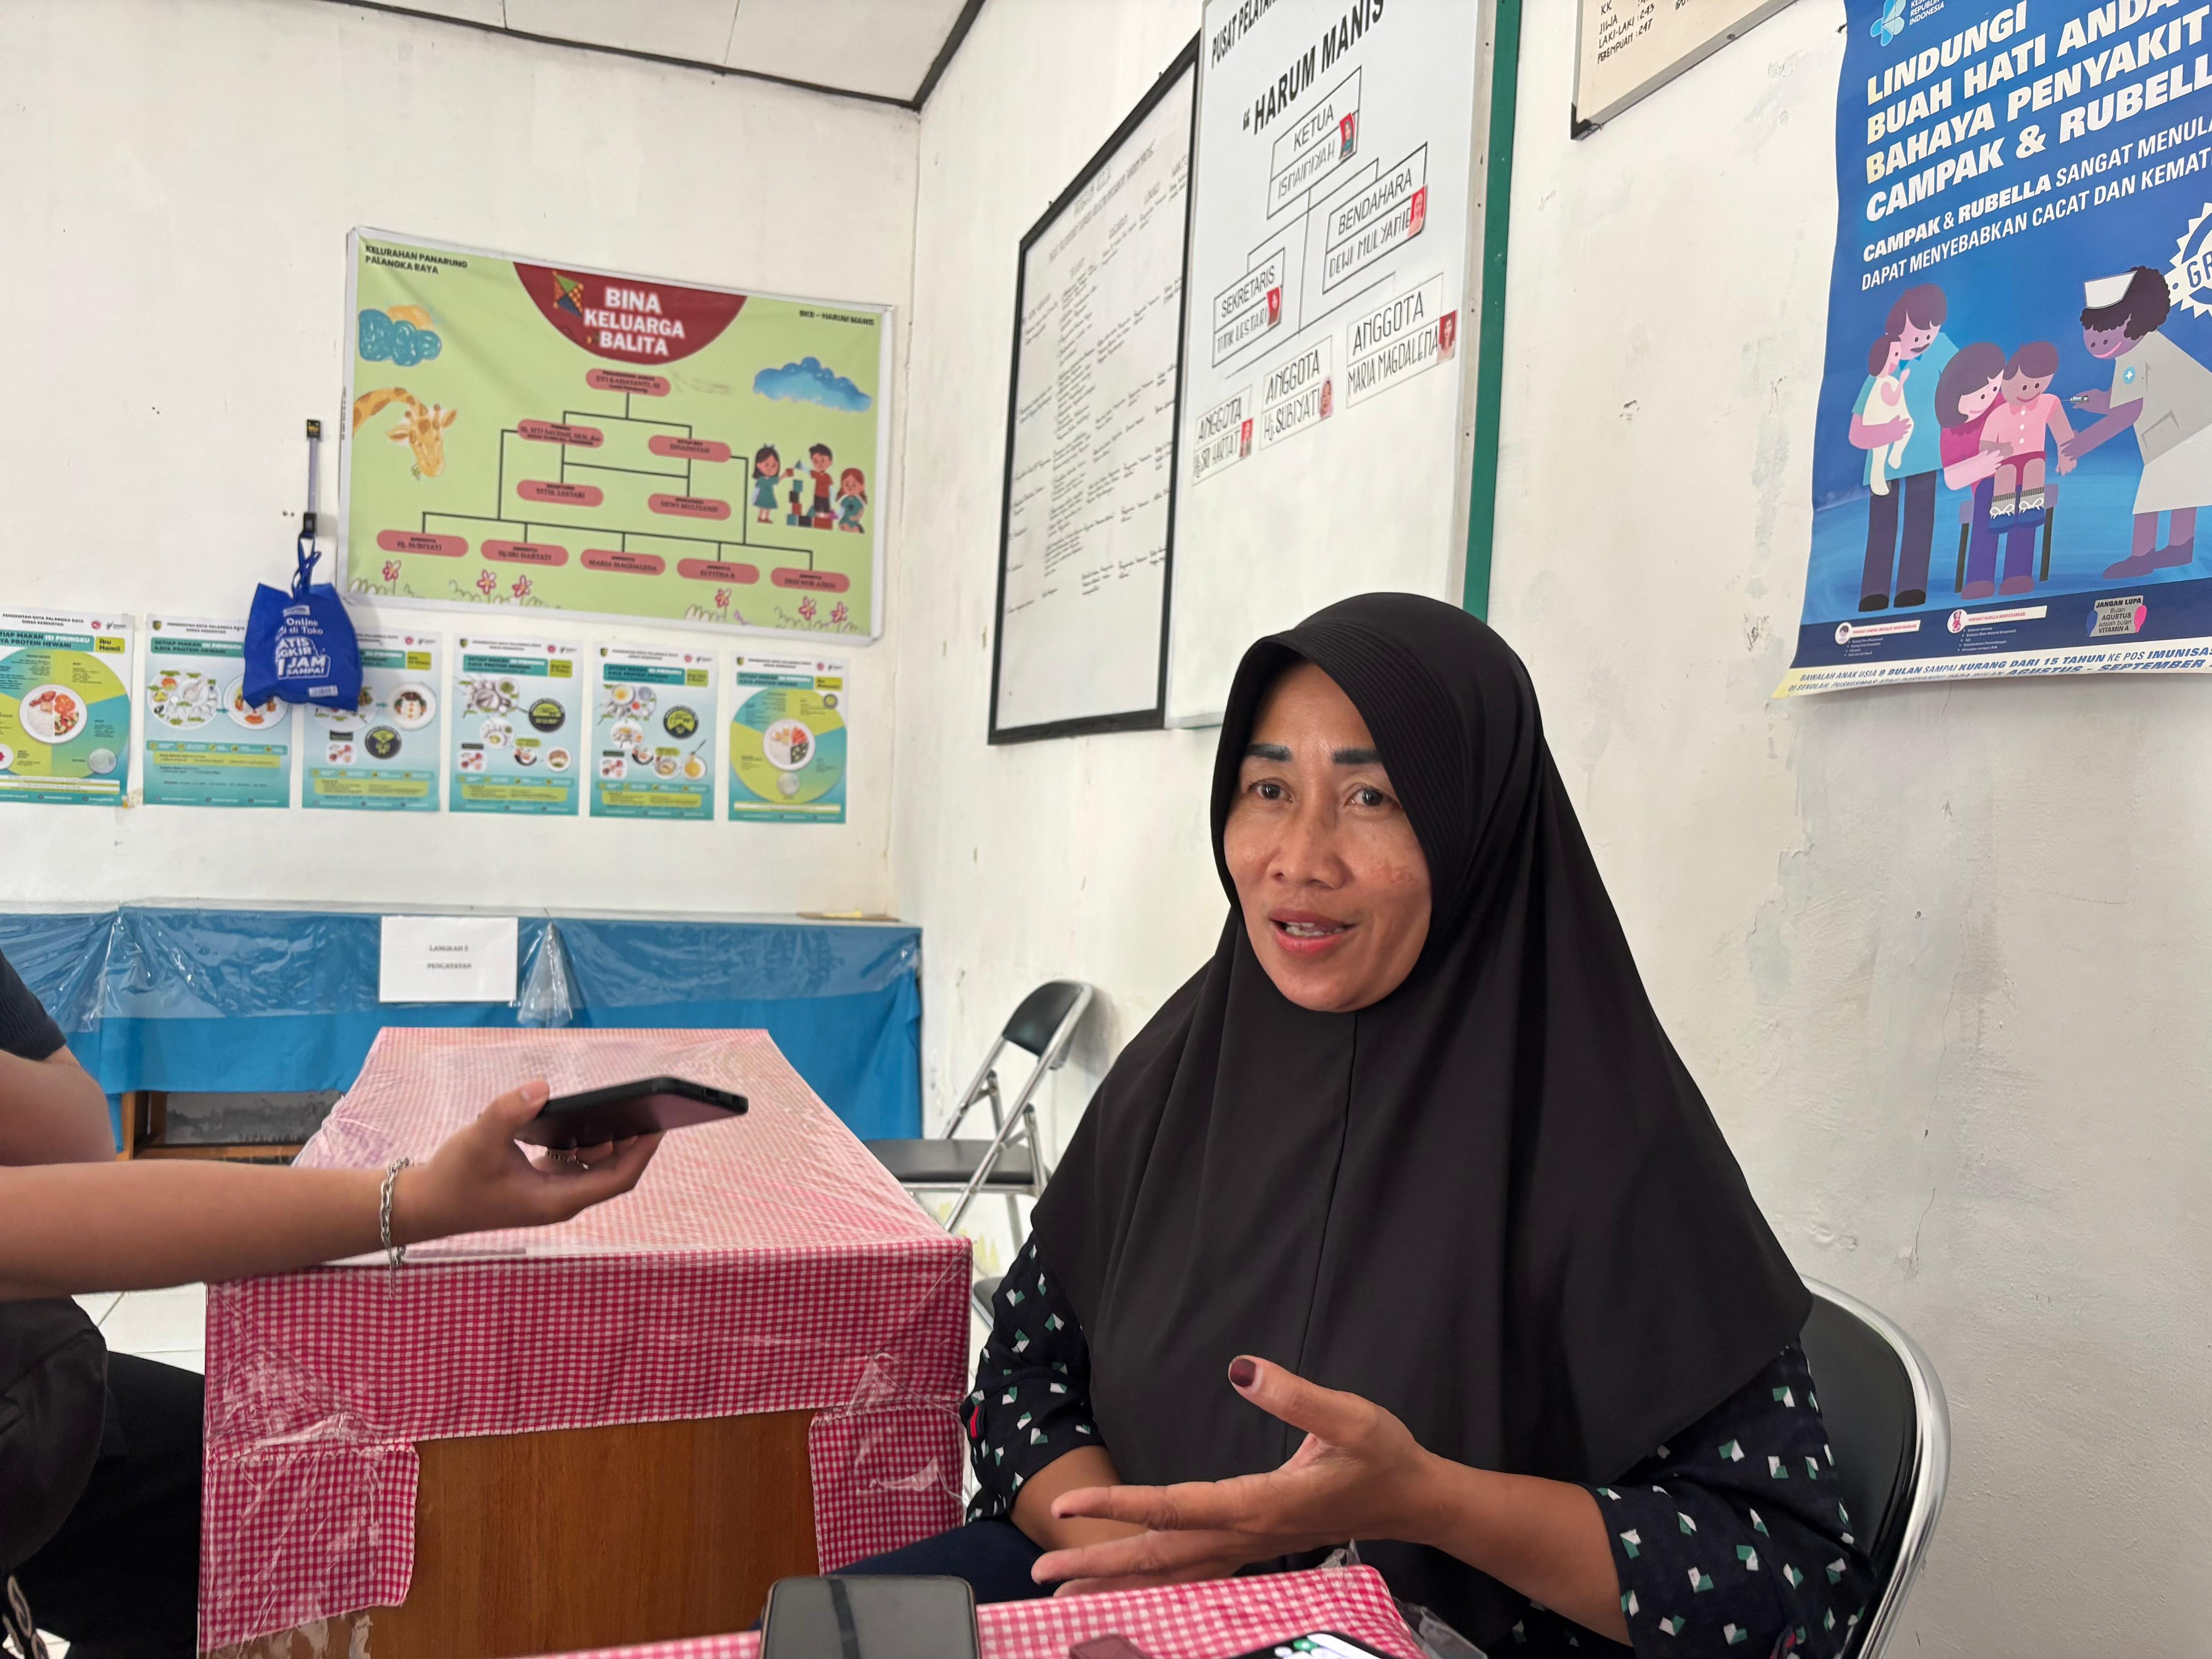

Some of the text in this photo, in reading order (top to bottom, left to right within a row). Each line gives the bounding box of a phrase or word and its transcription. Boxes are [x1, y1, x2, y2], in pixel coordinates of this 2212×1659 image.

[1601, 0, 1612, 15] KK
[1909, 1, 1944, 26] INDONESIA
[1599, 14, 1618, 35] JIWA
[1211, 13, 1237, 69] PUSAT
[1597, 33, 1633, 64] PEREMPUAN
[1867, 1, 2027, 105] LINDUNGI
[1867, 78, 1952, 145] BUAH
[1964, 34, 2046, 99] HATI
[1867, 4, 2210, 184] BAHAYA PENYAKIT
[1294, 104, 1334, 152] KETUA
[1866, 53, 2212, 222] CAMPAK & RUBELL
[1338, 168, 1412, 236] BENDAHARA
[1863, 216, 1940, 262] CAMPAK
[1943, 211, 1955, 230] &
[1958, 174, 2051, 224] RUBELLA
[2056, 143, 2133, 187] SANGAT
[1862, 146, 2212, 290] DAPAT MENYEBABKAN CACAT DAN KEMAT
[365, 245, 468, 269] KELURAHAN PANARUNG
[365, 255, 439, 274] PALANGKA RAYA
[1329, 246, 1353, 278] DEWI
[605, 287, 663, 315] BINA
[1221, 265, 1275, 318] SEKRETARIS
[584, 308, 686, 339] KELUARGA
[1352, 291, 1424, 356] ANGGOTA
[599, 330, 669, 357] BALITA
[1347, 325, 1438, 397] MARIA MAGDALENA
[1265, 349, 1320, 405] ANGGOTA
[2096, 599, 2123, 608] JANGAN
[2101, 612, 2132, 621] AGUSTUS
[286, 618, 319, 627] Online
[301, 626, 324, 635] Toko
[279, 638, 310, 648] ATIS
[280, 646, 312, 657] GKIR
[287, 655, 326, 668] JAM
[1800, 672, 1835, 681] BAWALAH
[1836, 671, 1858, 679] ANAK
[1888, 666, 1923, 675] BULAN
[1923, 664, 1958, 673] SAMPAI
[1958, 660, 2007, 671] KURANG
[2009, 658, 2040, 667] DARI
[2063, 654, 2106, 664] TAHUN
[2107, 653, 2121, 661] KE
[2123, 651, 2146, 660] POS
[2098, 659, 2206, 671] SEPTEMBER
